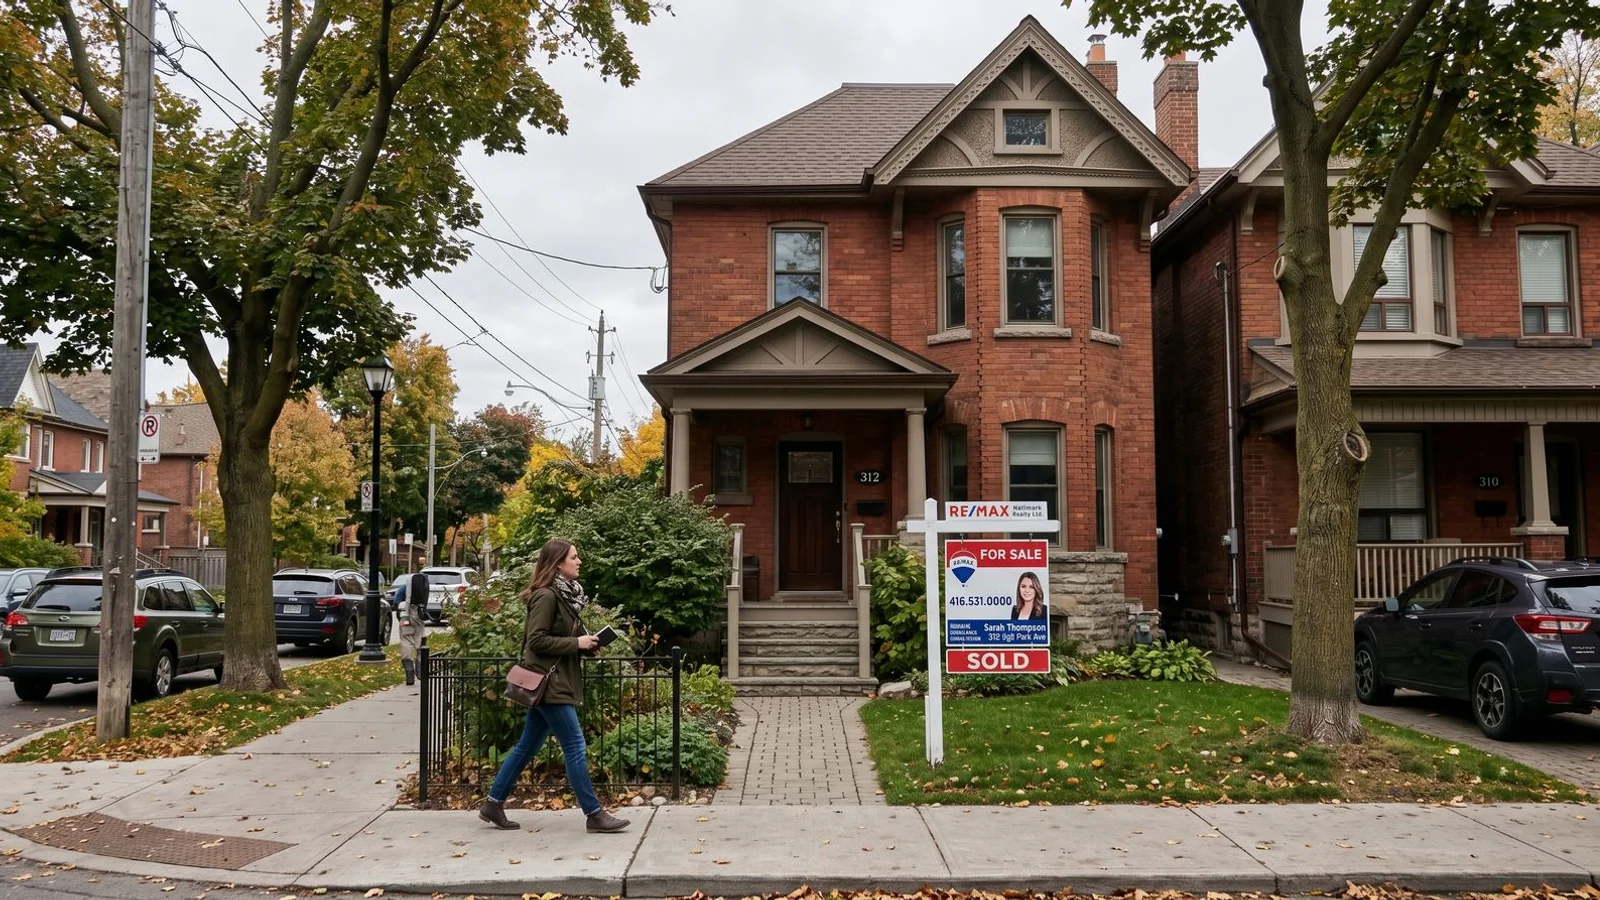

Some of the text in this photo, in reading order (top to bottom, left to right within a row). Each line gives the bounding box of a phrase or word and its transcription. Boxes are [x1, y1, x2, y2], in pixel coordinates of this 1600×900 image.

[860, 472, 880, 482] 312
[1479, 476, 1499, 487] 310
[949, 505, 1010, 517] RE/MAX
[980, 549, 1042, 560] FOR SALE
[949, 596, 1012, 606] 416.531.0000
[983, 623, 1046, 633] Sarah Thompson
[988, 633, 1000, 641] 312
[1016, 633, 1032, 641] Park
[1033, 633, 1046, 641] Ave
[967, 652, 1030, 670] SOLD
